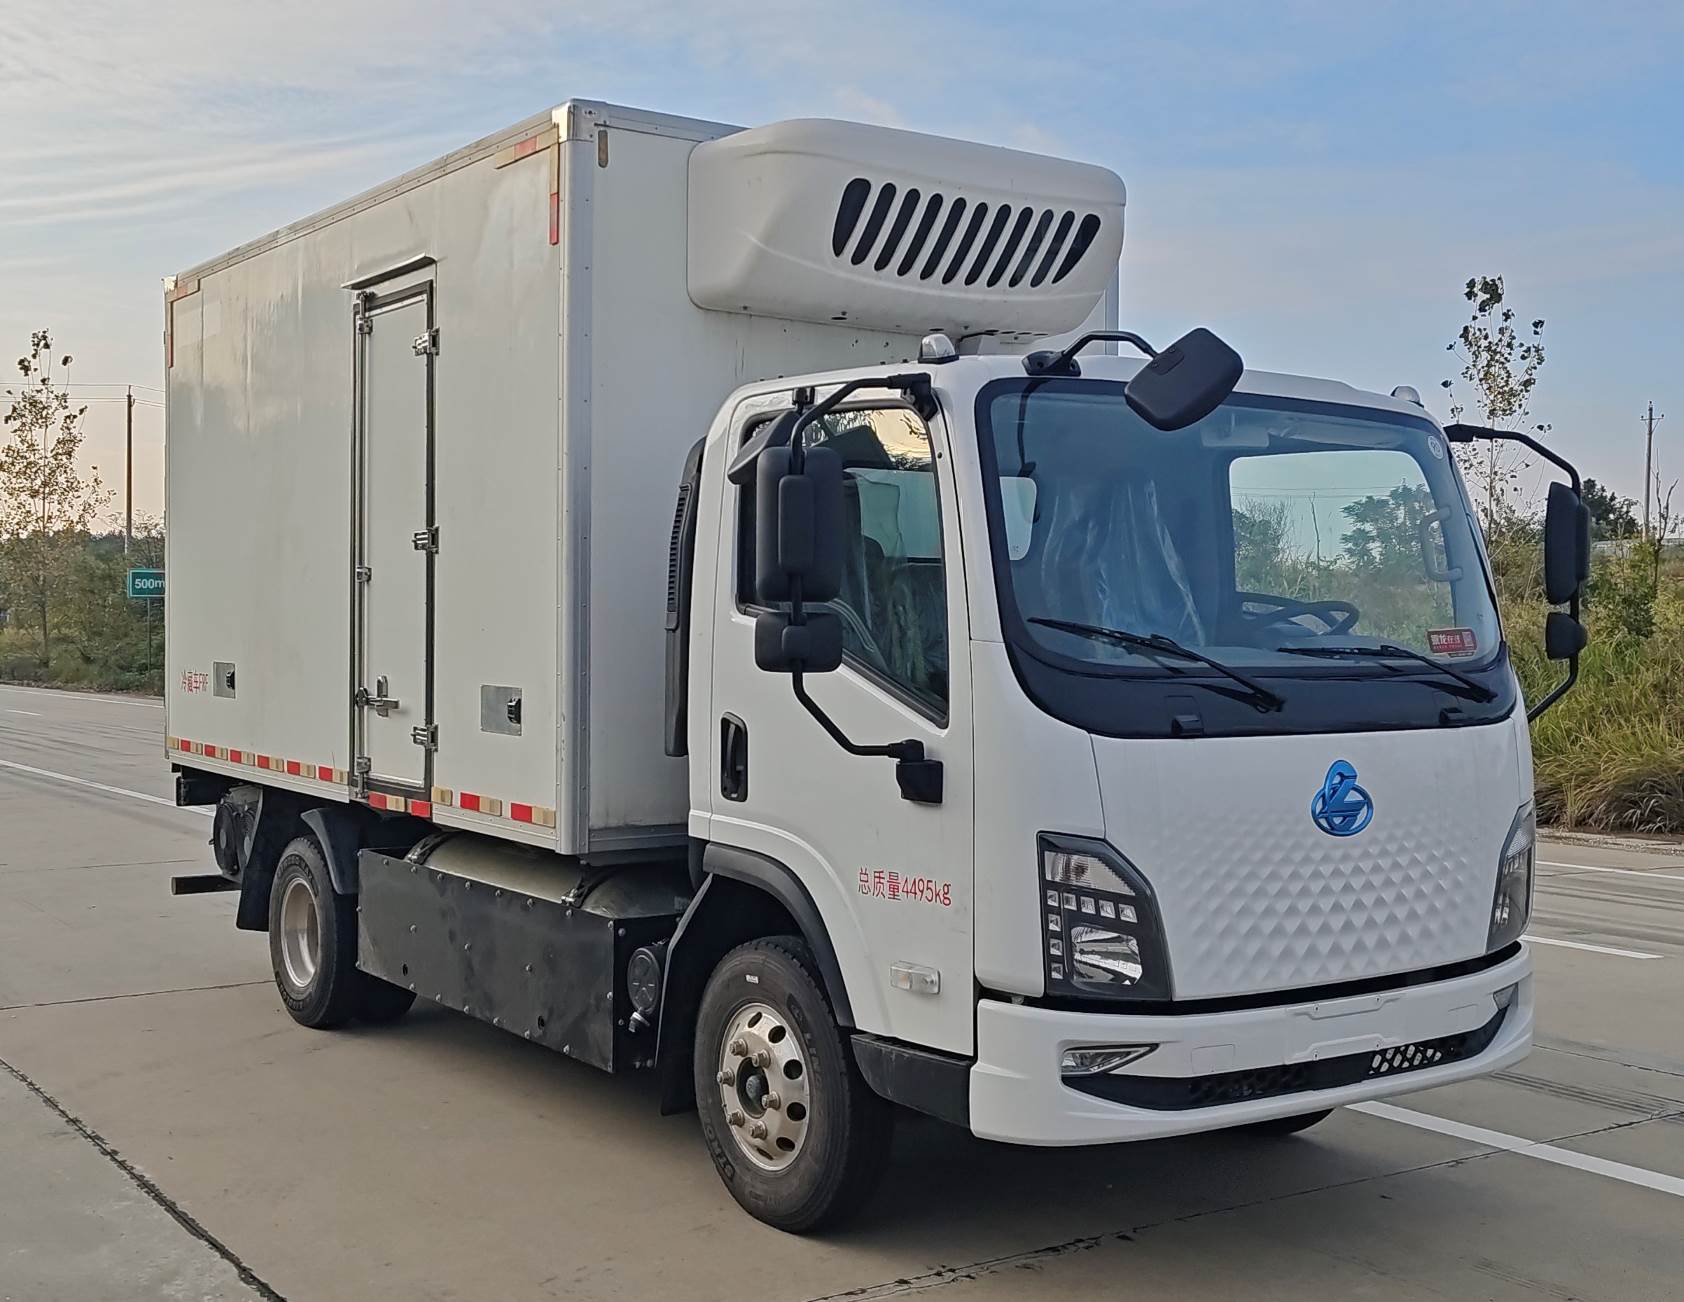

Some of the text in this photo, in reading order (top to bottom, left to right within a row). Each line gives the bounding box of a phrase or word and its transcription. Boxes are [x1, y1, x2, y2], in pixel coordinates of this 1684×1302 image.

[134, 578, 165, 589] 500m
[858, 867, 951, 906] 总质量4495kg
